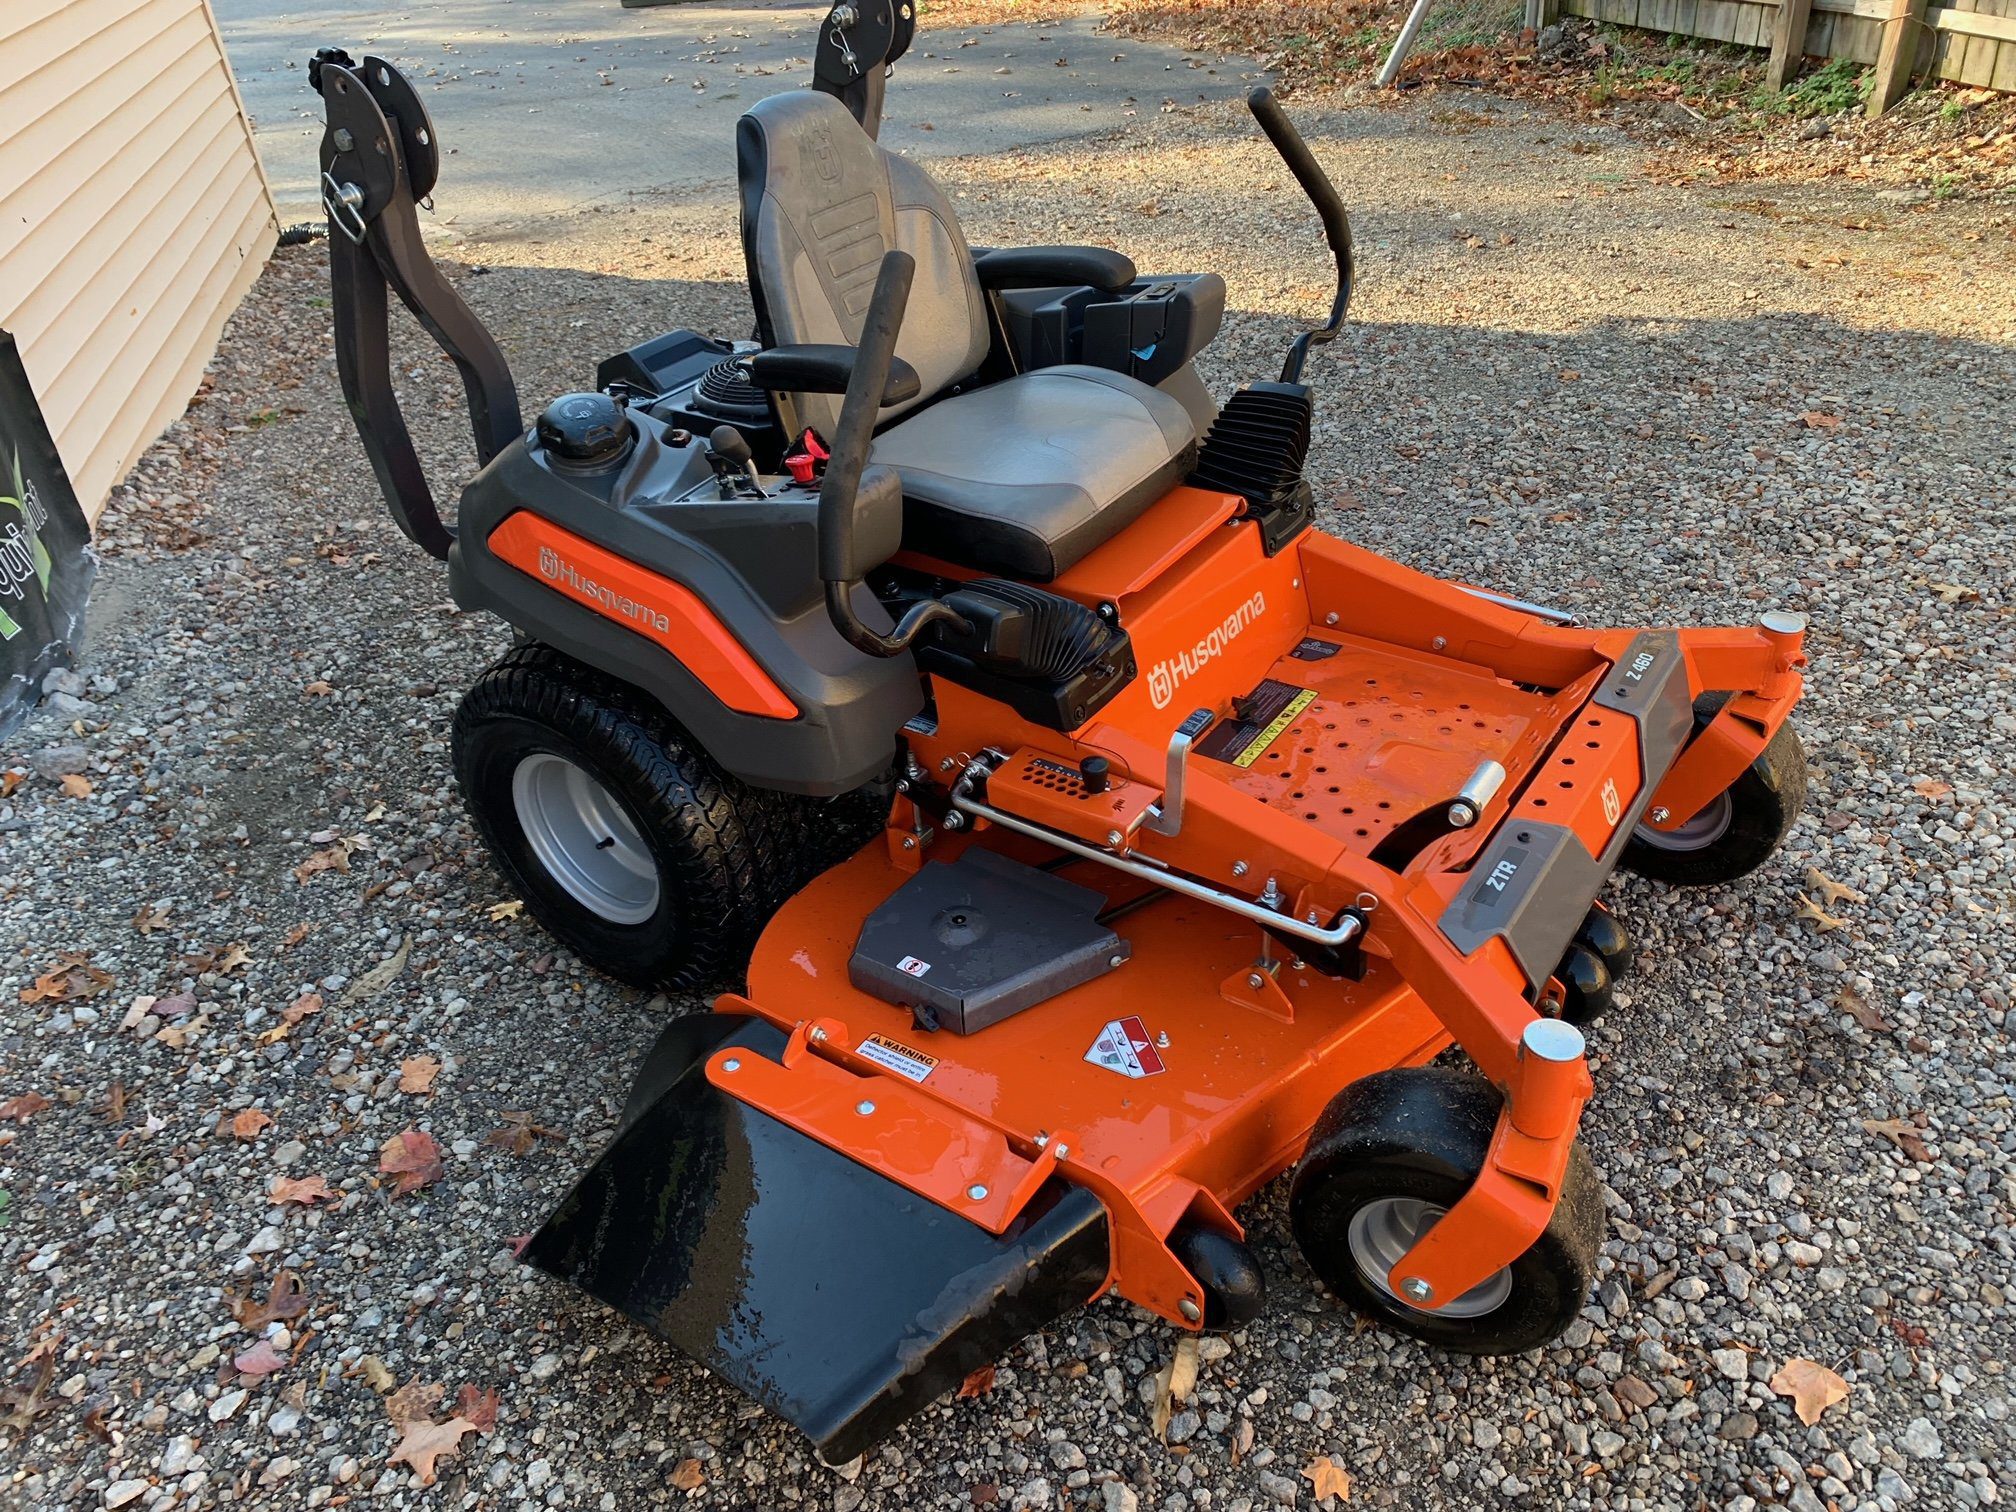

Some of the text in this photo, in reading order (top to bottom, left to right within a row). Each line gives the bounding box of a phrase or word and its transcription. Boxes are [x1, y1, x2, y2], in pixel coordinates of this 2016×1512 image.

[559, 560, 670, 633] Husqvarna
[1169, 591, 1266, 688] Husqvarna
[1625, 652, 1654, 681] Z 460
[1485, 860, 1517, 892] ZTR
[883, 1039, 934, 1066] WARNING
